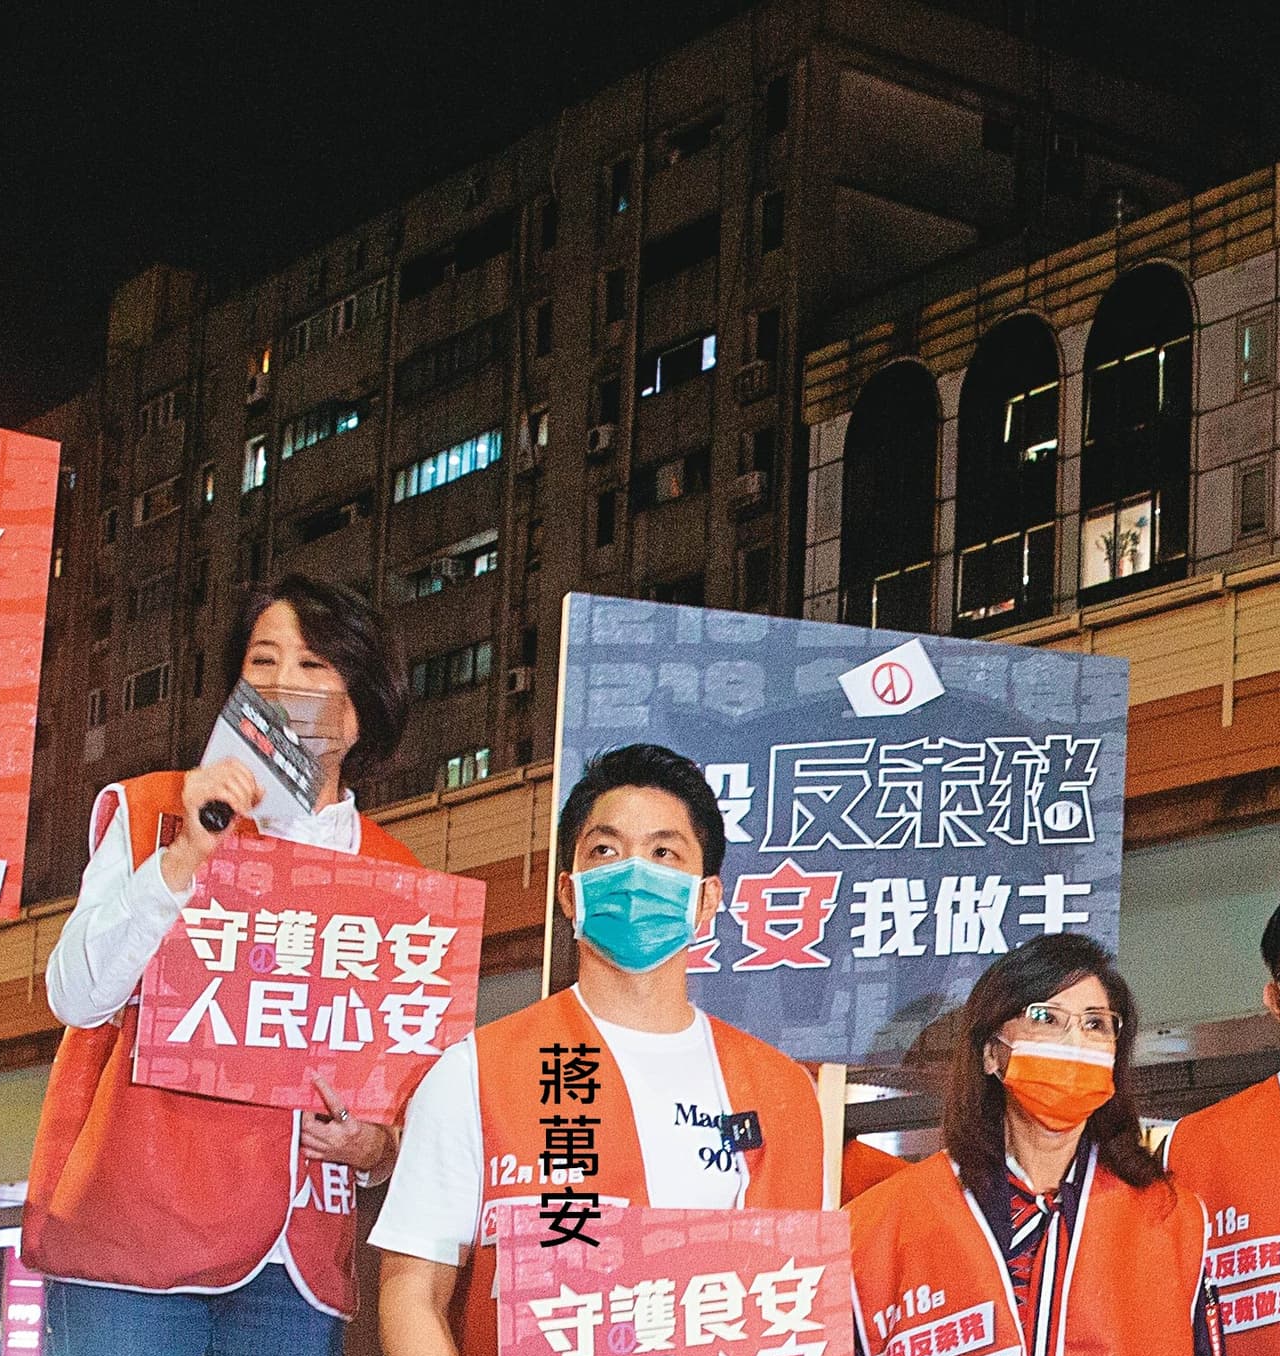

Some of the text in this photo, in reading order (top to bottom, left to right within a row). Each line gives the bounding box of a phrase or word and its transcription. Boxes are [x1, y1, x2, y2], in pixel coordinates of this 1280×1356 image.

[180, 897, 459, 986] 守護食安
[167, 977, 454, 1056] 人民心安
[293, 1160, 356, 1215] 人民
